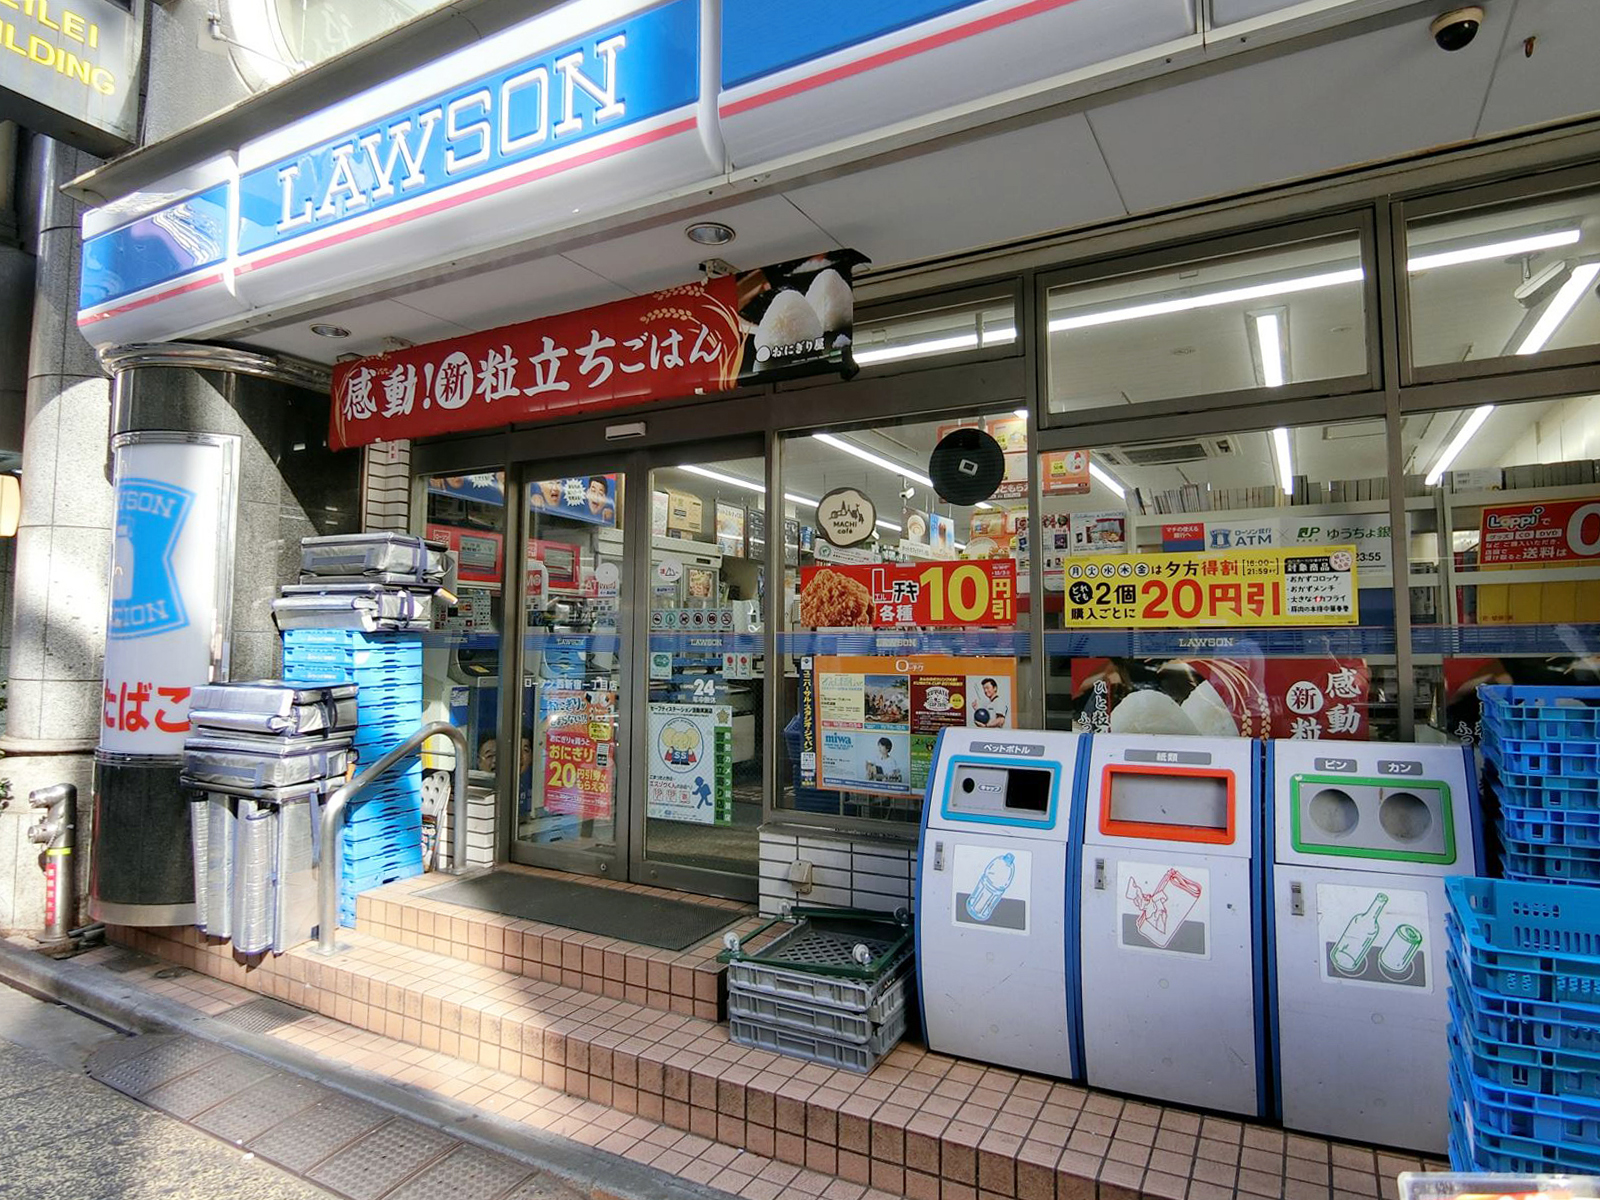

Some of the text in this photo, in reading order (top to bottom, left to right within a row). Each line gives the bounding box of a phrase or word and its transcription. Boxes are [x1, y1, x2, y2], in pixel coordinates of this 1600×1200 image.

[276, 35, 626, 234] LAWSON
[772, 337, 825, 357] おにぎり屋
[833, 520, 858, 529] MACHI
[1487, 506, 1545, 530] Loppi
[1235, 535, 1271, 546] ATM
[1522, 546, 1568, 559] 送料は
[1287, 561, 1330, 572] 対象商品
[1290, 575, 1339, 583] おかずコロッケ
[919, 564, 990, 622] 10
[1095, 582, 1137, 605] 2個
[1290, 585, 1335, 593] おかずメンチ
[992, 578, 1011, 620] 円引
[1141, 578, 1281, 619] 20円引
[879, 604, 914, 622] 各種
[1071, 608, 1136, 620] 購入ごとに
[1179, 638, 1235, 648] LAWSON
[693, 678, 716, 697] 24
[1325, 666, 1362, 735] 感動
[825, 732, 852, 745] miwa
[549, 745, 596, 763] おにぎり
[983, 743, 1031, 754] ペットボトル
[674, 751, 688, 760] SS
[1156, 752, 1178, 762] 紙類
[1324, 759, 1348, 770] ビン
[1387, 762, 1412, 773] カン
[547, 761, 577, 789] 20
